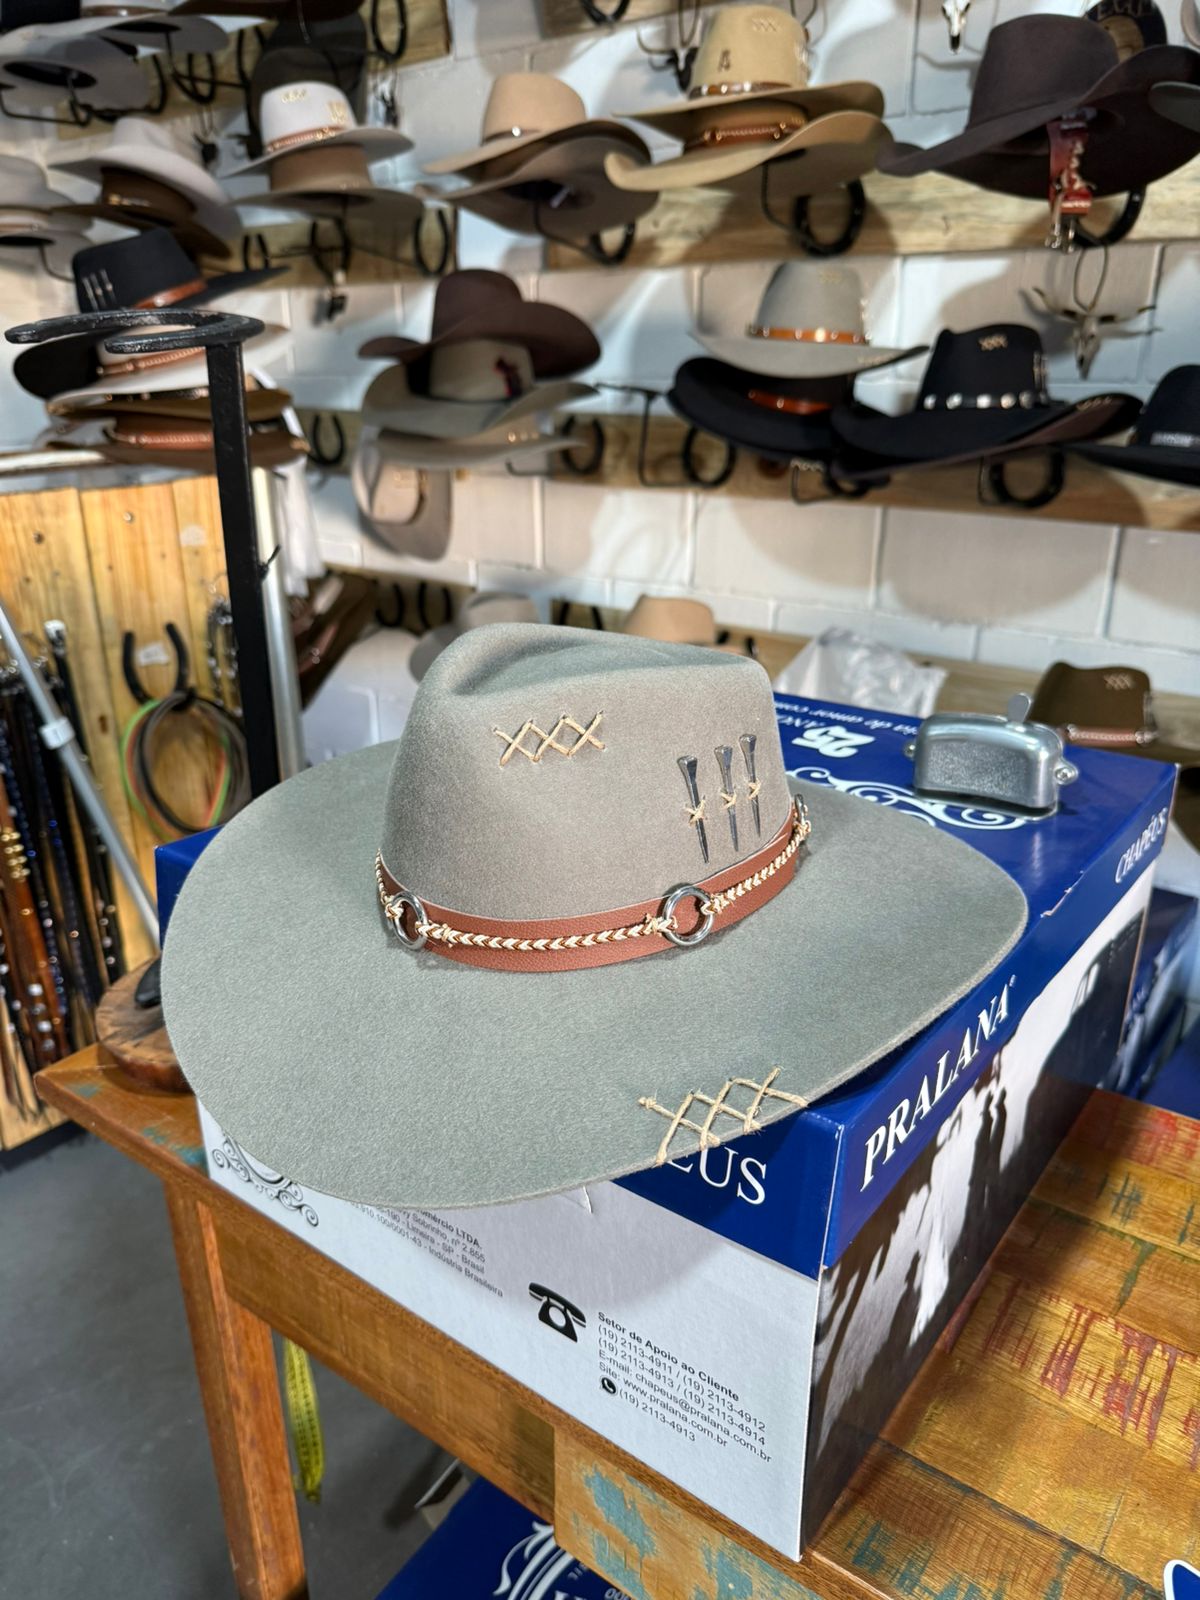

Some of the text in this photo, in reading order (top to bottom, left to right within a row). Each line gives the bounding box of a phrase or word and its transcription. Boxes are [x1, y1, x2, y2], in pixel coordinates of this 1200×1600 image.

[791, 725, 876, 757] 25
[860, 983, 1009, 1192] PRALANA
[428, 1246, 463, 1272] Indústria
[464, 1267, 504, 1297] Brasileira
[461, 1254, 485, 1275] Brasil
[598, 1311, 740, 1402] Setor de Apoio ao Cliente
[598, 1324, 618, 1343] (19)
[620, 1337, 673, 1375] 2113-4911
[683, 1375, 705, 1396] (19)
[707, 1389, 766, 1433] 2113-4912
[598, 1337, 618, 1356] (19)
[620, 1350, 674, 1389] 2113-4913
[683, 1387, 705, 1408] (19)
[707, 1402, 765, 1446] 2113-4914
[598, 1349, 772, 1463] E-mail: chapeus@pralana.com.br
[599, 1361, 728, 1447] Site: www.pralana.com.br
[619, 1388, 696, 1442] (19) 2113-4913
